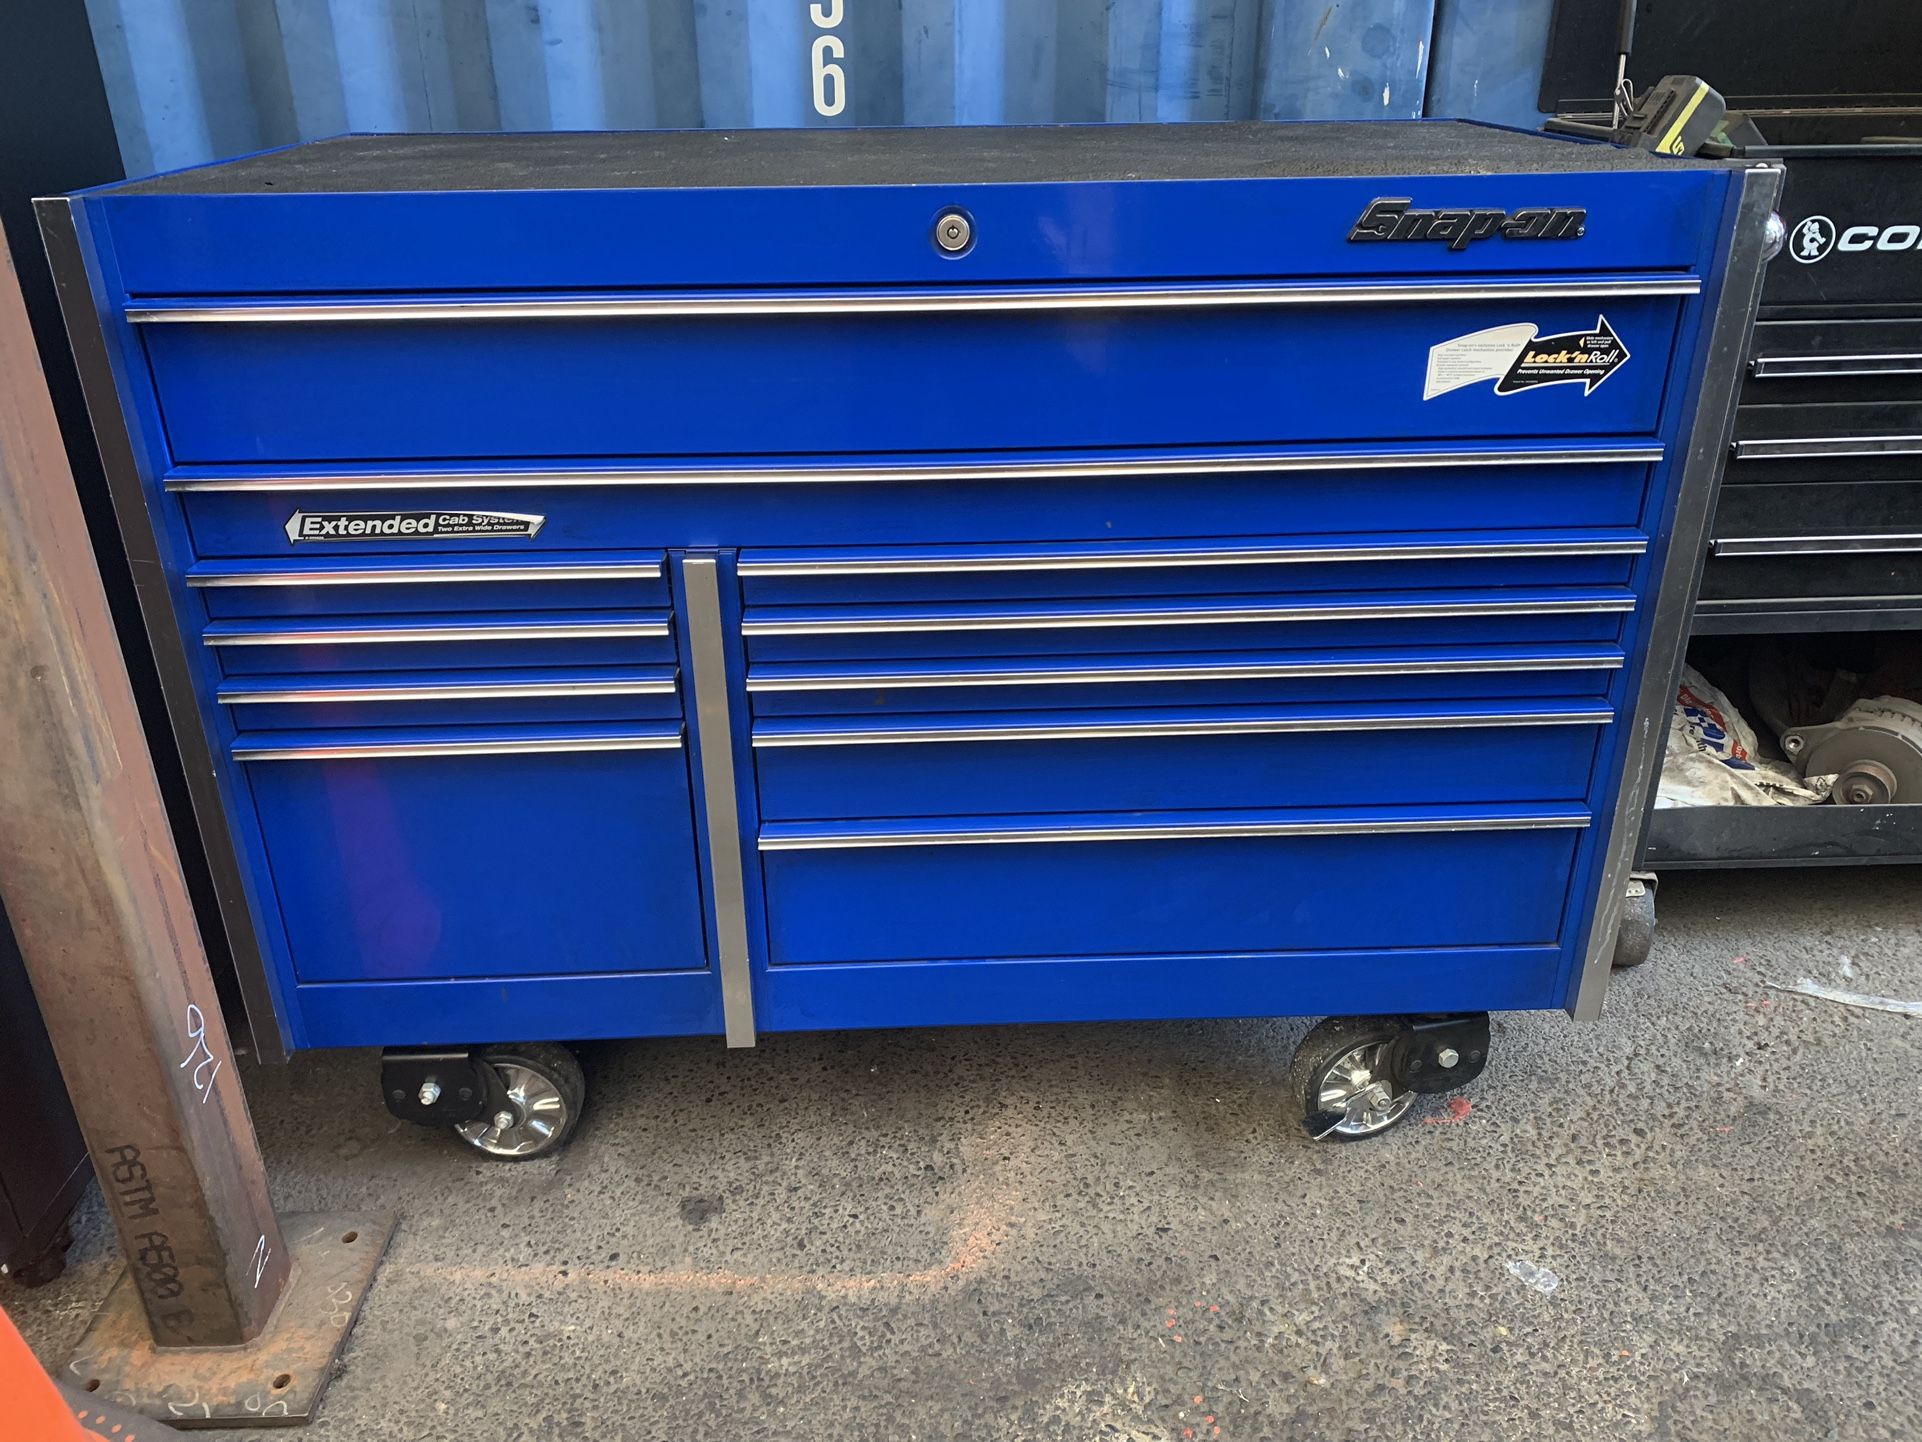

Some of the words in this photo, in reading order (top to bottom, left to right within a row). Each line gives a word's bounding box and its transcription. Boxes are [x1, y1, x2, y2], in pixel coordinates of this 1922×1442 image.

[1837, 225, 1922, 252] CO
[303, 515, 436, 535] Extended
[438, 514, 468, 525] Cab
[105, 1144, 160, 1220] ASTM
